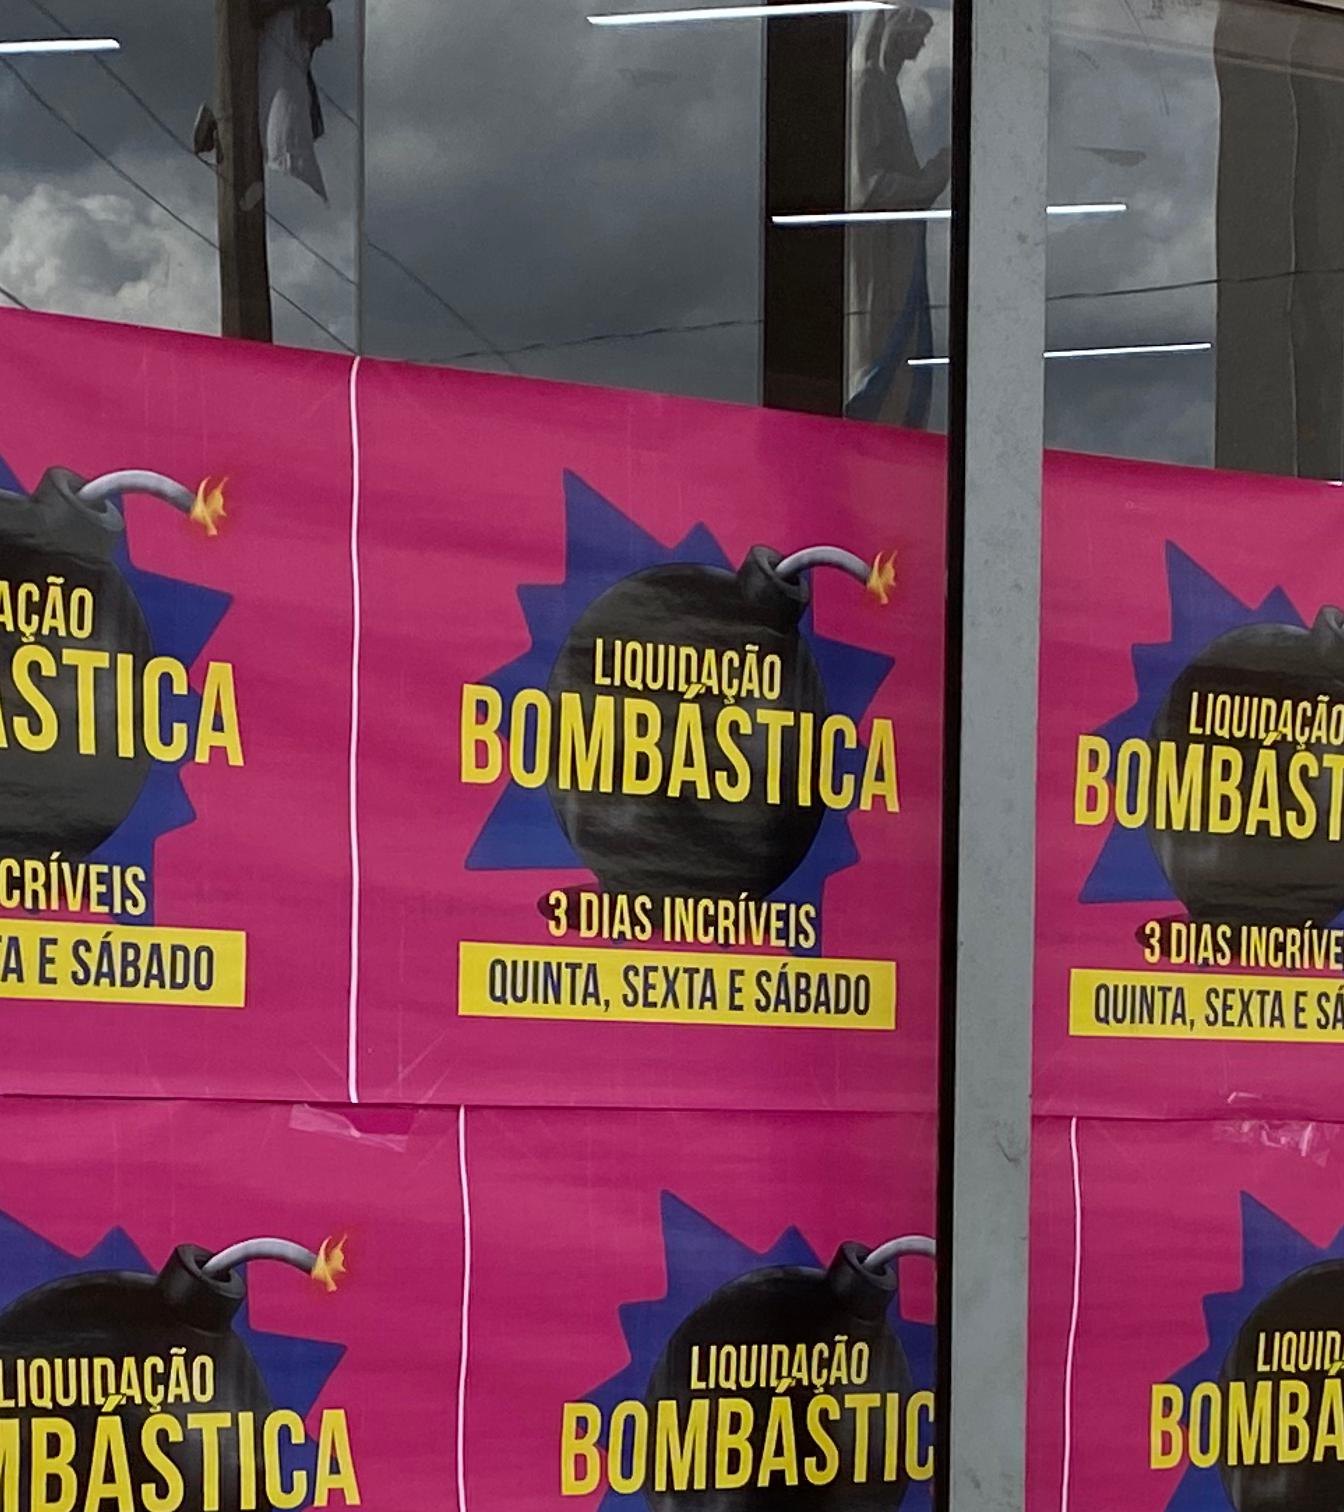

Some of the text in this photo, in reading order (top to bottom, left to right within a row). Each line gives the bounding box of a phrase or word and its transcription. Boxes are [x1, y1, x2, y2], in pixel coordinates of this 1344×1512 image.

[595, 638, 781, 703] LIQUIDAÇÃO
[461, 683, 899, 813] BOMBÁSTICA
[548, 890, 816, 948] 3 DIAS INCRÍVEIS
[1144, 921, 1160, 964] 3
[1170, 923, 1231, 967] DIAS
[40, 938, 58, 985] E
[72, 932, 214, 991] SÁBADO
[489, 958, 870, 1016] QUINTA, SEXTA E SÁBADO
[1094, 983, 1195, 1032] QUINTA,
[1205, 987, 1284, 1029] SEXTA
[1295, 991, 1307, 1029] E
[691, 1334, 869, 1394] LIQUIDAÇÃO
[561, 1378, 935, 1495] BOMBÁSTIC
